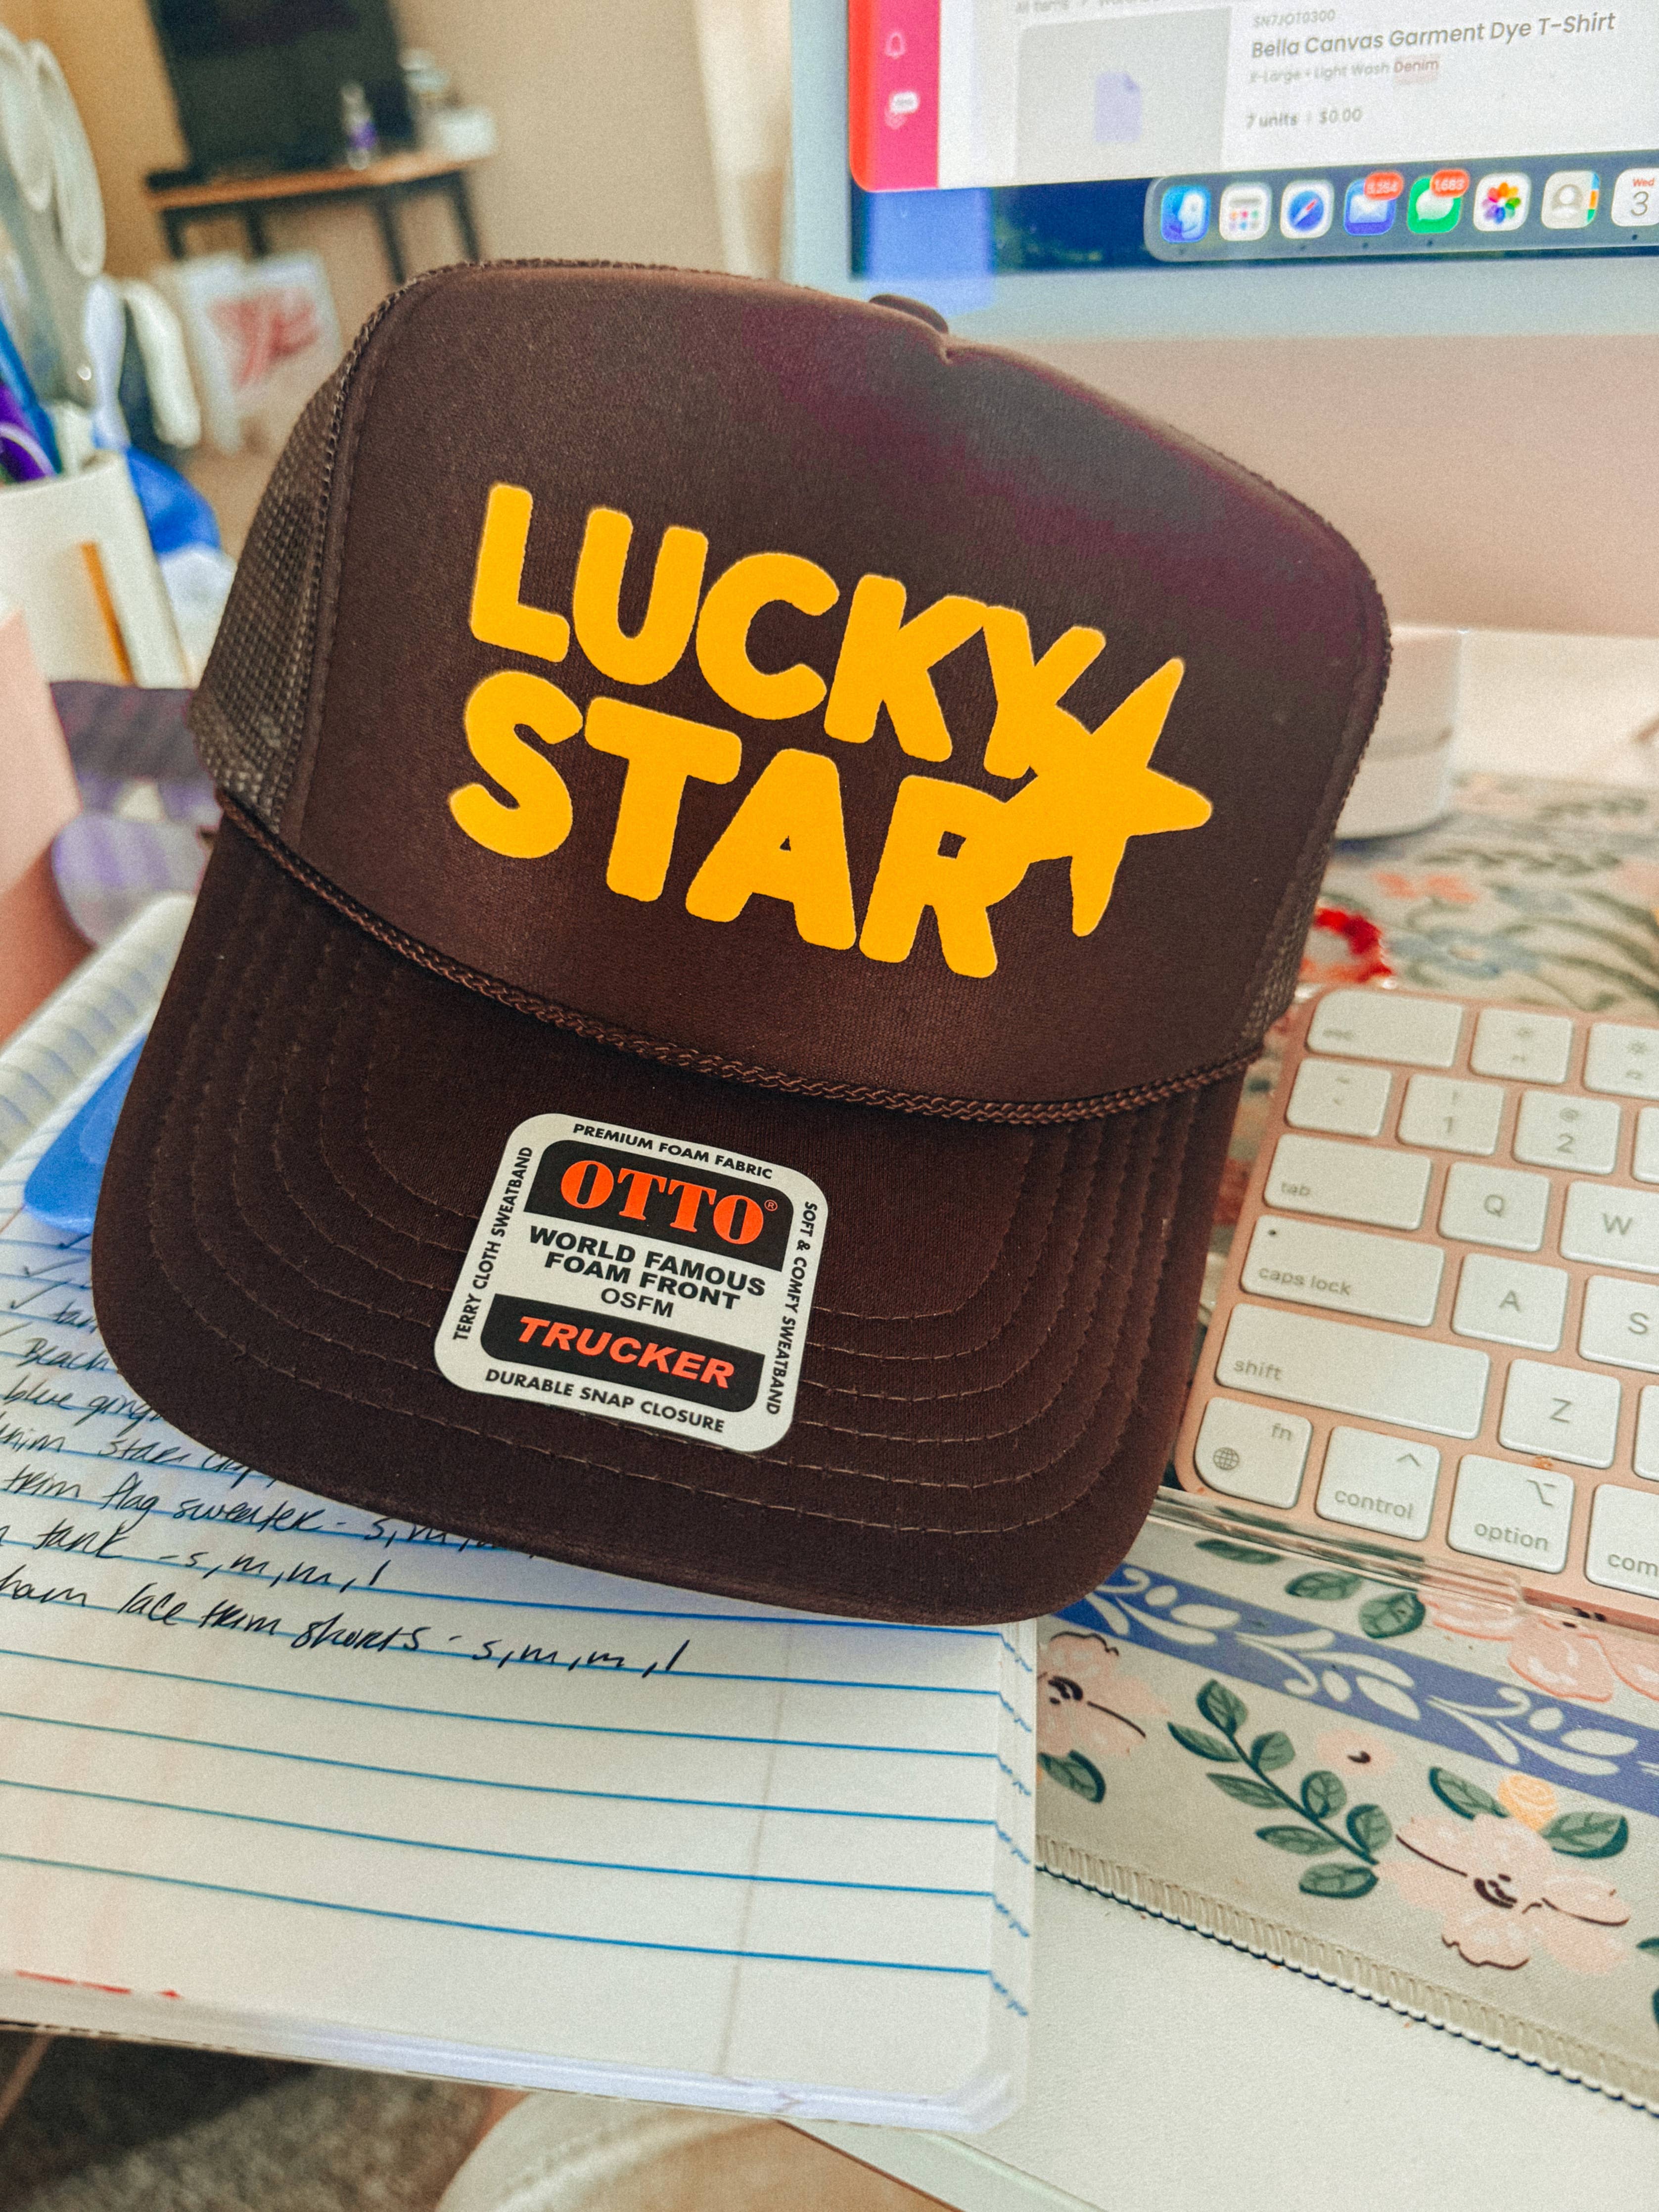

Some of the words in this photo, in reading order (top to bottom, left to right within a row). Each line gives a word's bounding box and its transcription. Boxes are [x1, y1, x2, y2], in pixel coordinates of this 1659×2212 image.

[1251, 39, 1300, 58] Bella
[1305, 34, 1383, 53] Canvas
[1389, 22, 1485, 46] Garment
[1490, 21, 1532, 45] Dye
[1538, 11, 1616, 36] T-Shirt
[1351, 62, 1389, 76] Wash
[1393, 58, 1440, 74] Denim
[1259, 111, 1298, 128] units
[1319, 108, 1364, 125] $0.00
[1633, 178, 1655, 187] Wed
[1630, 191, 1649, 216] 3
[470, 483, 1107, 779] LUCKY
[447, 671, 1029, 979] STAR
[573, 1123, 653, 1150] PREMIUM
[658, 1143, 709, 1162] FOAM
[715, 1155, 773, 1180] FABRIC
[1556, 1132, 1575, 1154] 2
[1281, 1179, 1311, 1198] tab
[795, 1201, 817, 1237] SOFT
[1483, 1193, 1506, 1218] Q
[1602, 1212, 1634, 1236] W
[453, 1293, 482, 1340] TERRY
[473, 1242, 502, 1290] CLOTH
[491, 1147, 533, 1238] SWEATBAND
[796, 1240, 811, 1252] &
[529, 1225, 636, 1263] WORLD
[643, 1252, 766, 1297] FAMOUS
[544, 1252, 631, 1284] FOAM
[641, 1273, 740, 1310] FRONT
[786, 1256, 807, 1314] COMFY
[1258, 1265, 1306, 1287] caps
[1310, 1275, 1351, 1295] lock
[600, 1289, 674, 1318] OSFM
[1499, 1290, 1522, 1313] A
[1627, 1312, 1650, 1336] S
[518, 1316, 735, 1388] TRUCKER
[766, 1317, 796, 1415] SWEATBAND
[1233, 1358, 1284, 1382] shift
[3, 1374, 73, 1410] blue
[485, 1369, 574, 1396] DURABLE
[579, 1386, 635, 1409] SNAP
[641, 1401, 725, 1433] CLOSURE
[1549, 1397, 1572, 1425] Z
[1271, 1422, 1293, 1442] fn
[99, 1471, 160, 1532] flag
[173, 1498, 326, 1532] sweater
[1334, 1487, 1415, 1521] control
[33, 1518, 130, 1559] tank
[1473, 1520, 1549, 1553] option
[117, 1582, 188, 1626] lace
[291, 1613, 431, 1652] shorts
